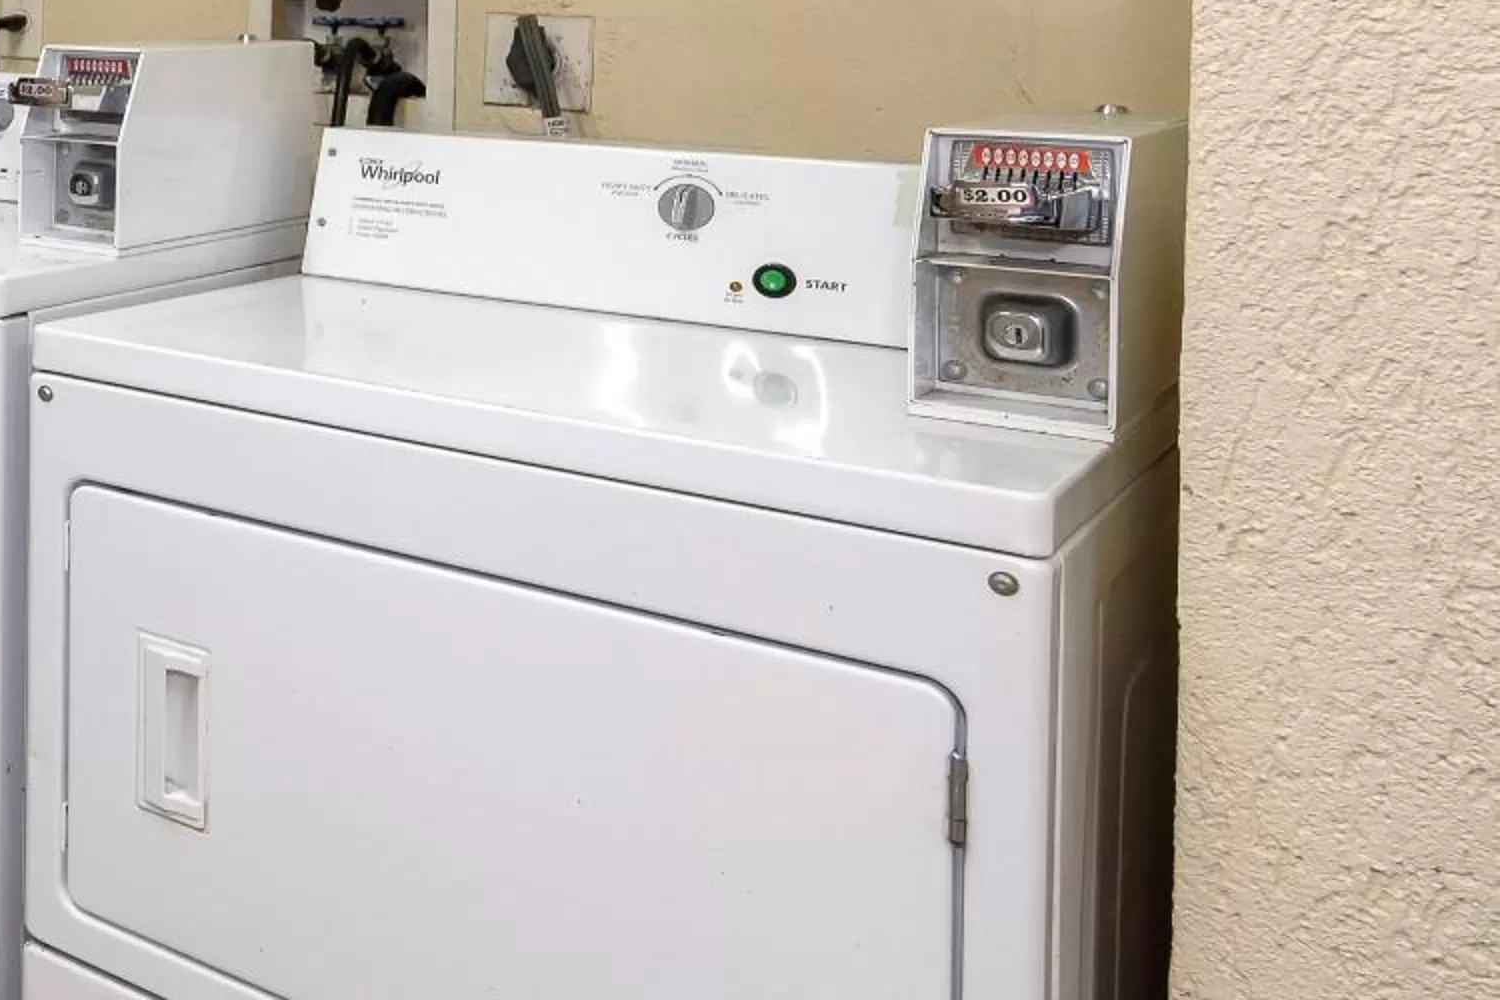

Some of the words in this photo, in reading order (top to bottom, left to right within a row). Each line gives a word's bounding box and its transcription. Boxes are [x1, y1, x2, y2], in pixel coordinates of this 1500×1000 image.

[361, 165, 441, 186] Whirlpool
[963, 189, 1028, 203] $2.00
[805, 279, 847, 292] START
